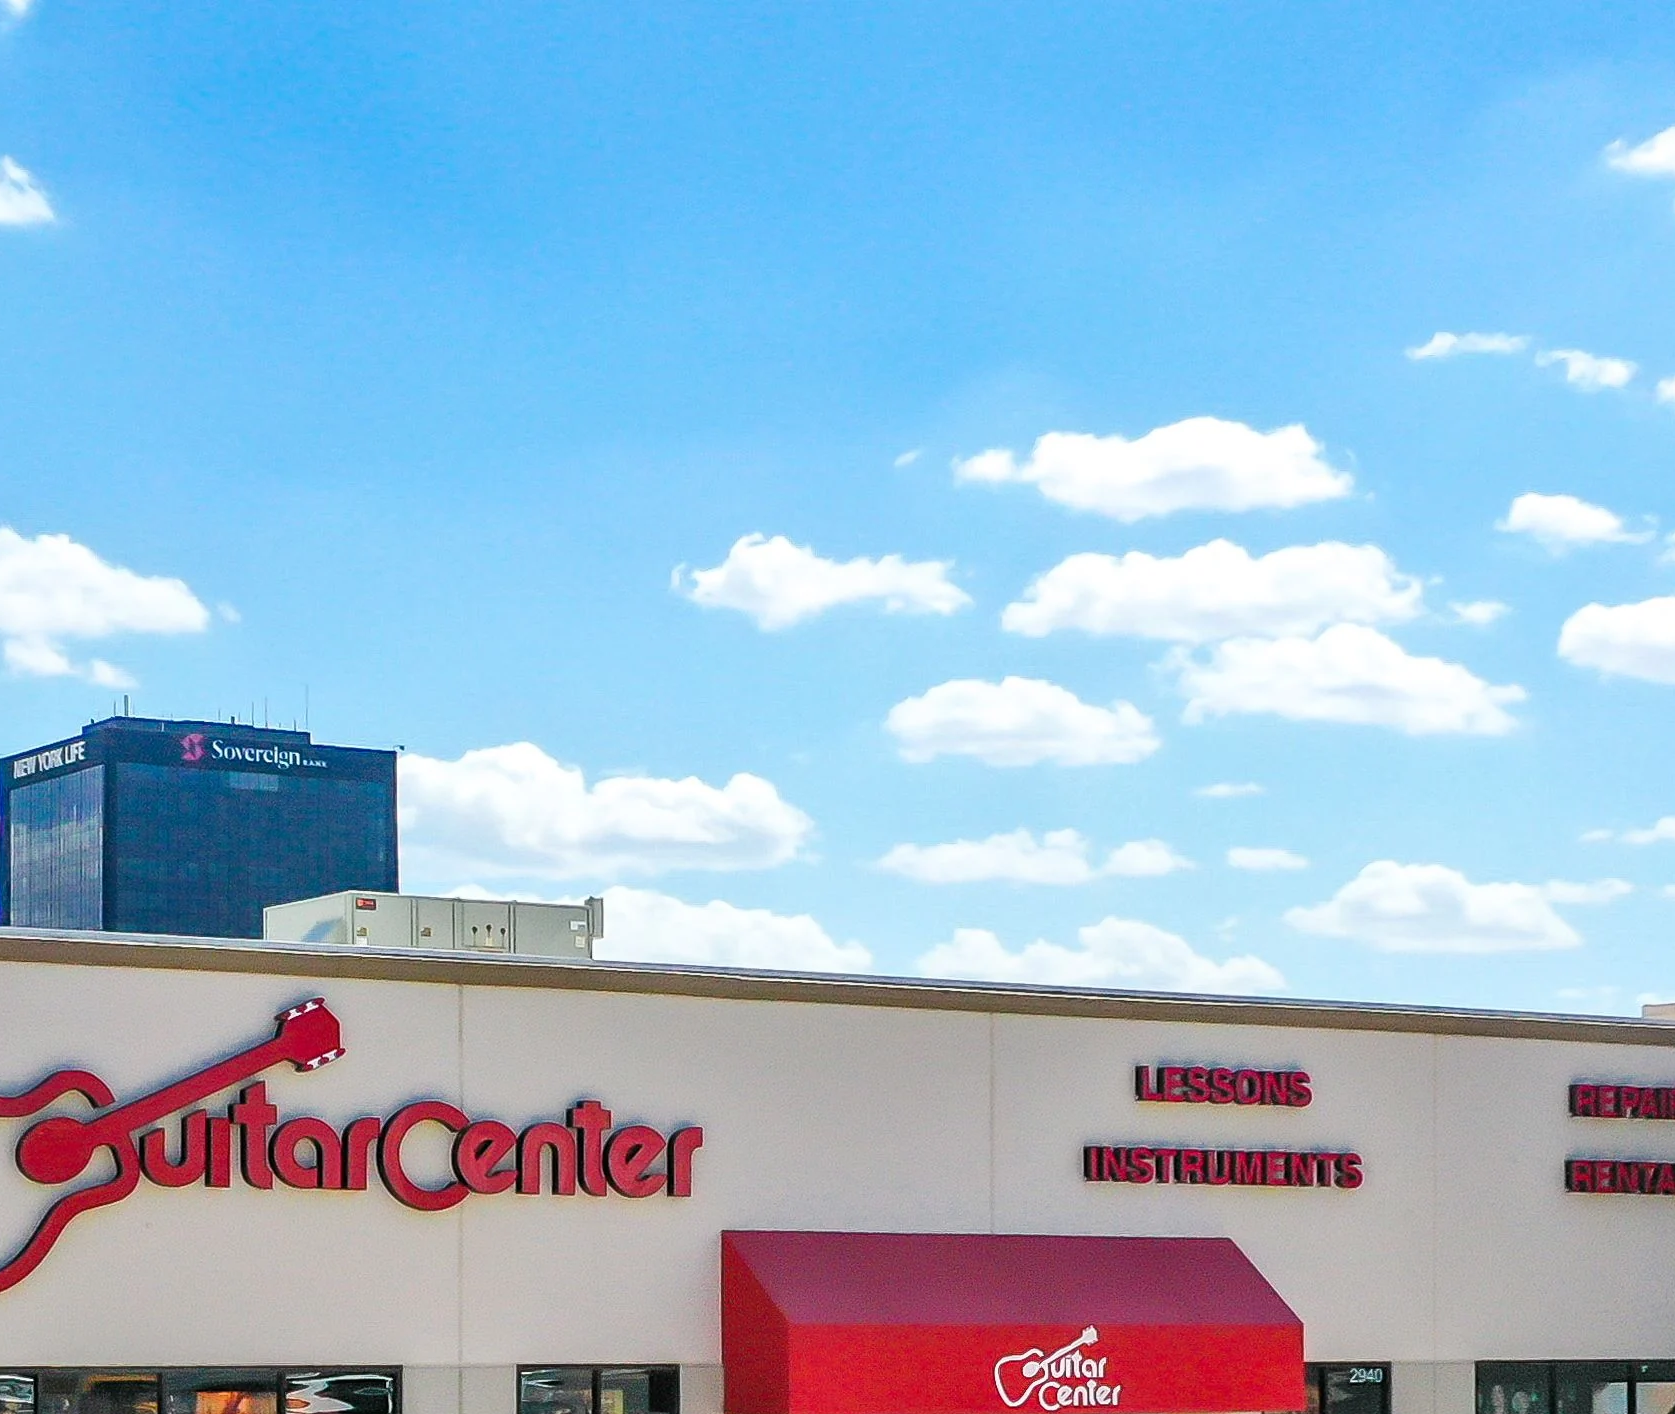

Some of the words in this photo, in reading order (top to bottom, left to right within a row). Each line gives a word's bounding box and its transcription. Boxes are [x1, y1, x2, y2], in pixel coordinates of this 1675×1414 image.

[13, 756, 37, 779] NEW
[37, 747, 64, 772] YORK
[65, 741, 86, 764] LIFE
[211, 740, 301, 769] Sovereign
[1135, 1065, 1314, 1108] LESSONS
[1083, 1146, 1364, 1189] INSTRUMENTS
[994, 1325, 1107, 1407] Guitar
[1349, 1367, 1384, 1383] 2940
[1038, 1379, 1122, 1411] Center
